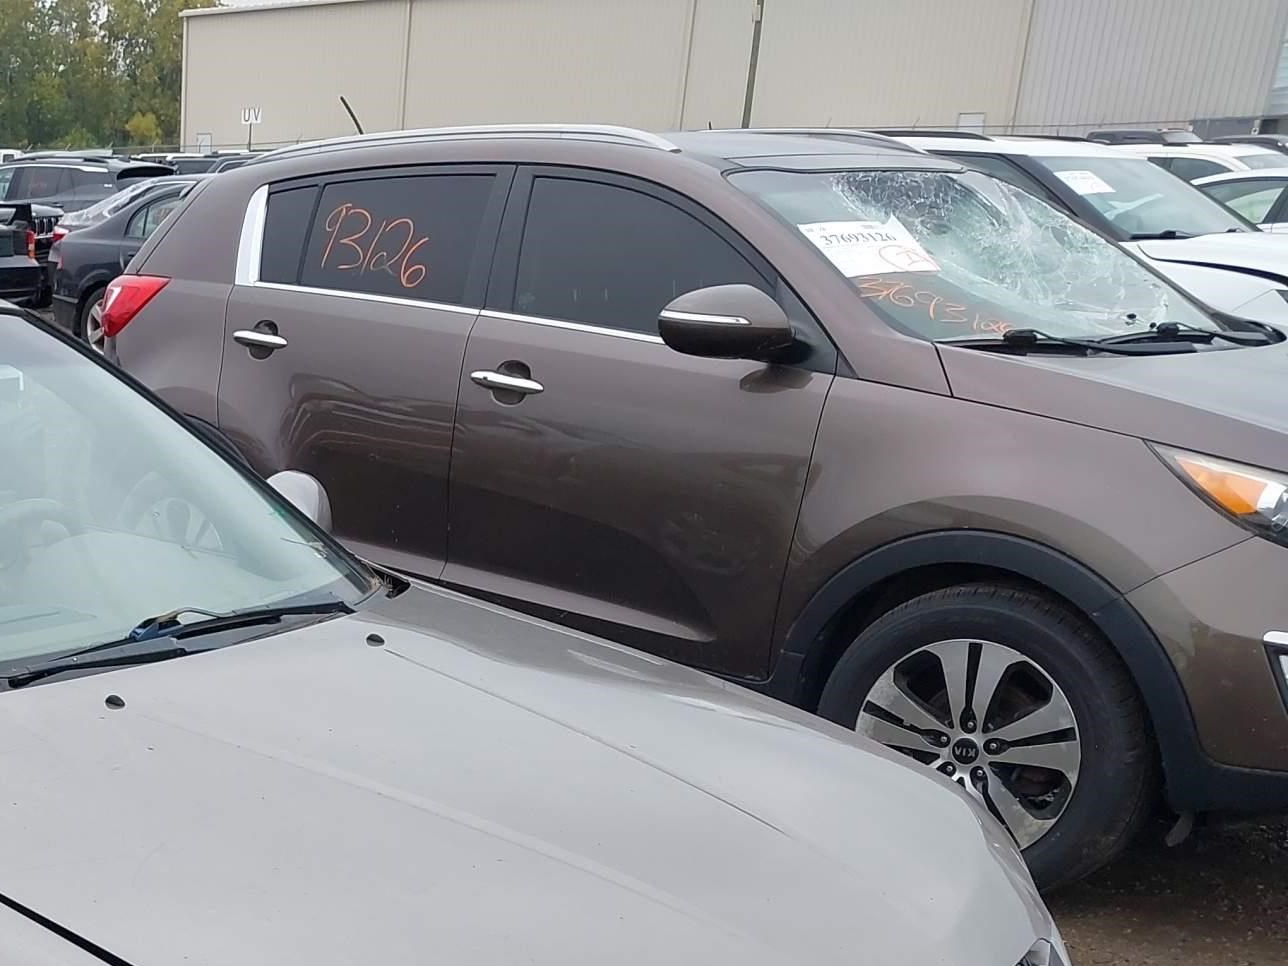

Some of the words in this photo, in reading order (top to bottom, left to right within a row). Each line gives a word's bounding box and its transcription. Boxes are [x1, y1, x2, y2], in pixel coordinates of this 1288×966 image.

[243, 106, 260, 122] UV
[819, 232, 896, 246] 37693126
[954, 746, 976, 757] KIA
